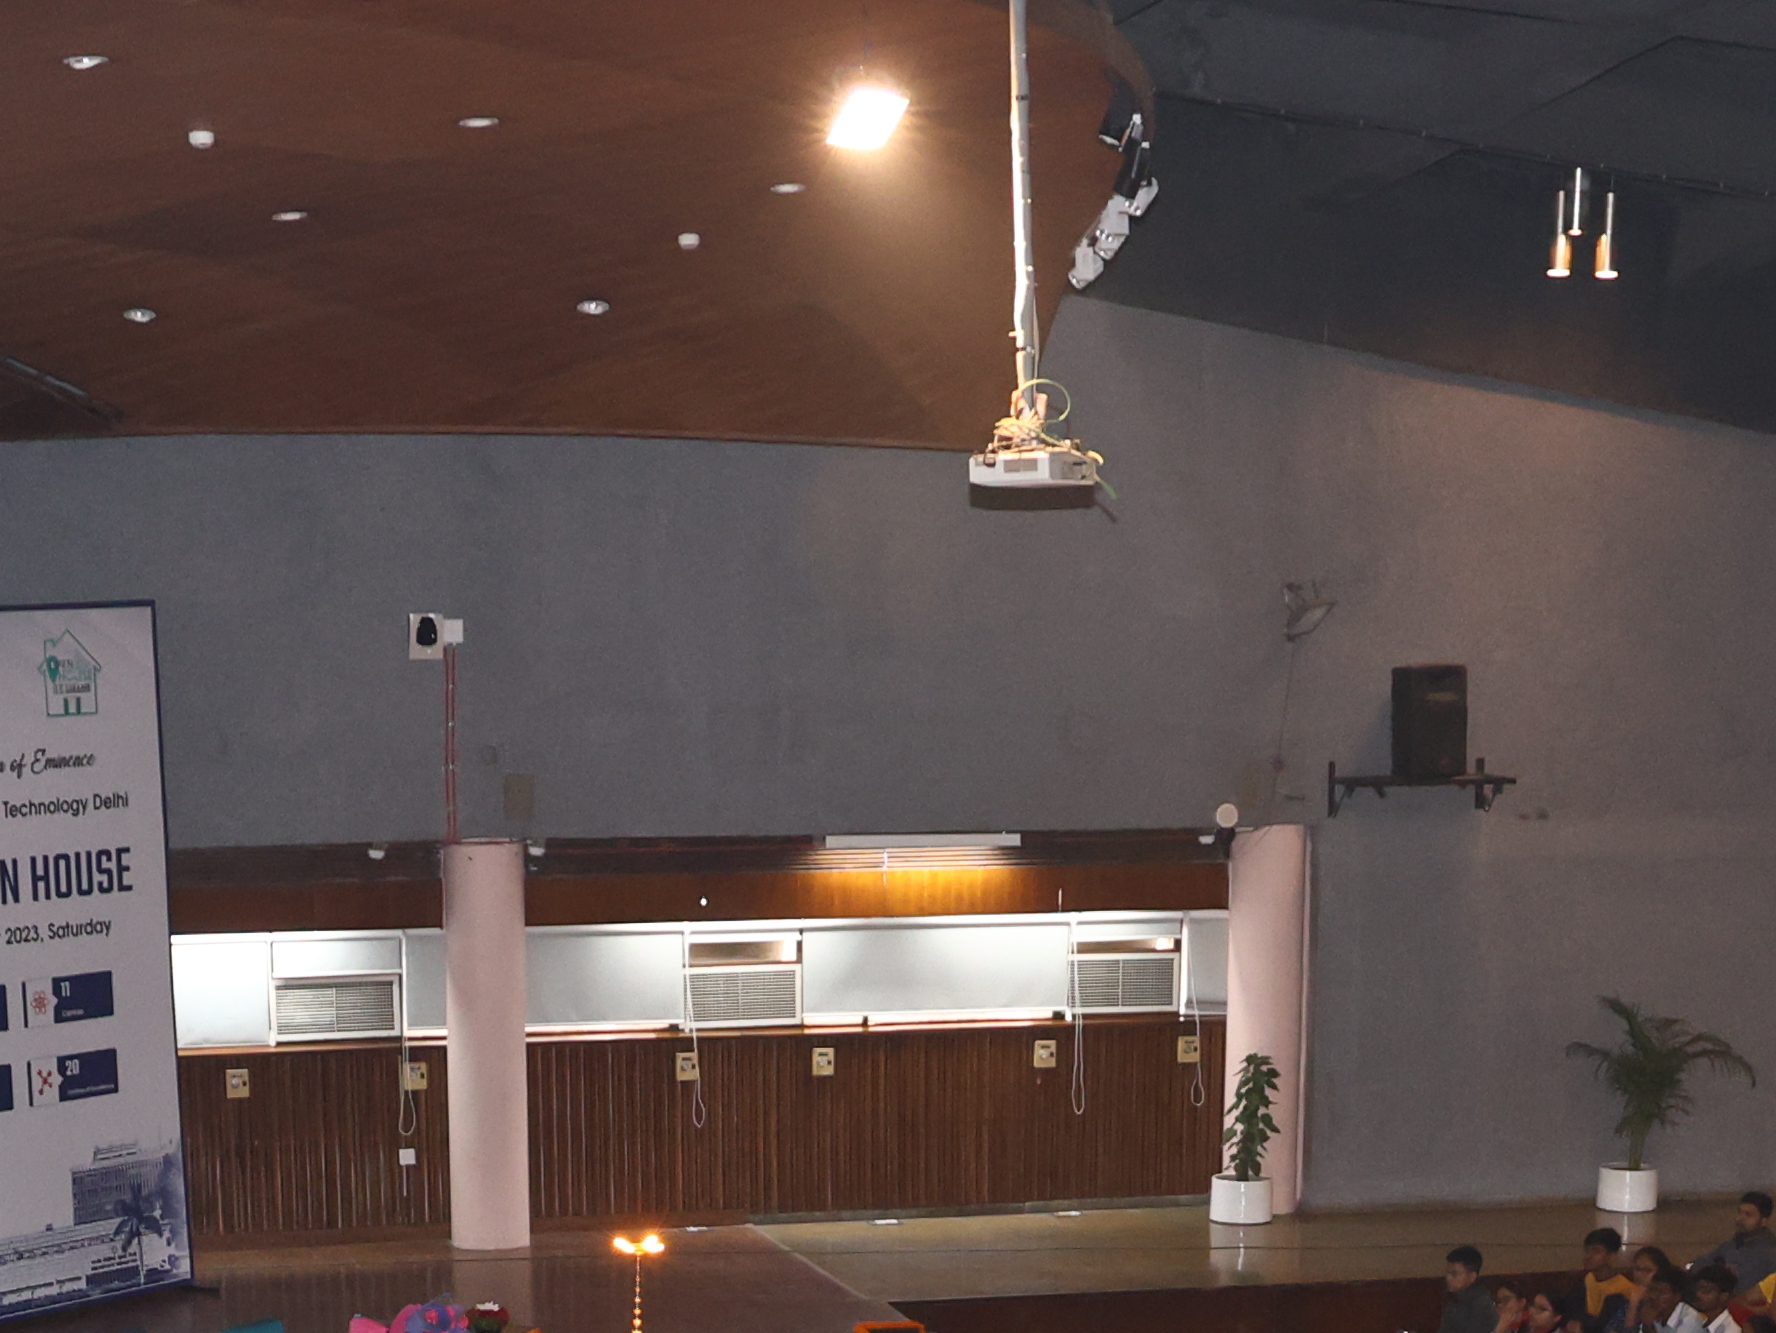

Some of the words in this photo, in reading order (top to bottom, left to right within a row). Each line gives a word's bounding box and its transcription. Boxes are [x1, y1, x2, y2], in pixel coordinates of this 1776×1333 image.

[9, 752, 26, 779] of
[30, 748, 96, 775] Eminence
[3, 797, 88, 819] Technology
[93, 791, 130, 811] Delhi
[29, 846, 134, 902] HOUSE
[4, 924, 44, 946] 2023,
[47, 918, 113, 942] Saturday
[60, 981, 71, 997] 11
[65, 1059, 80, 1075] 20
